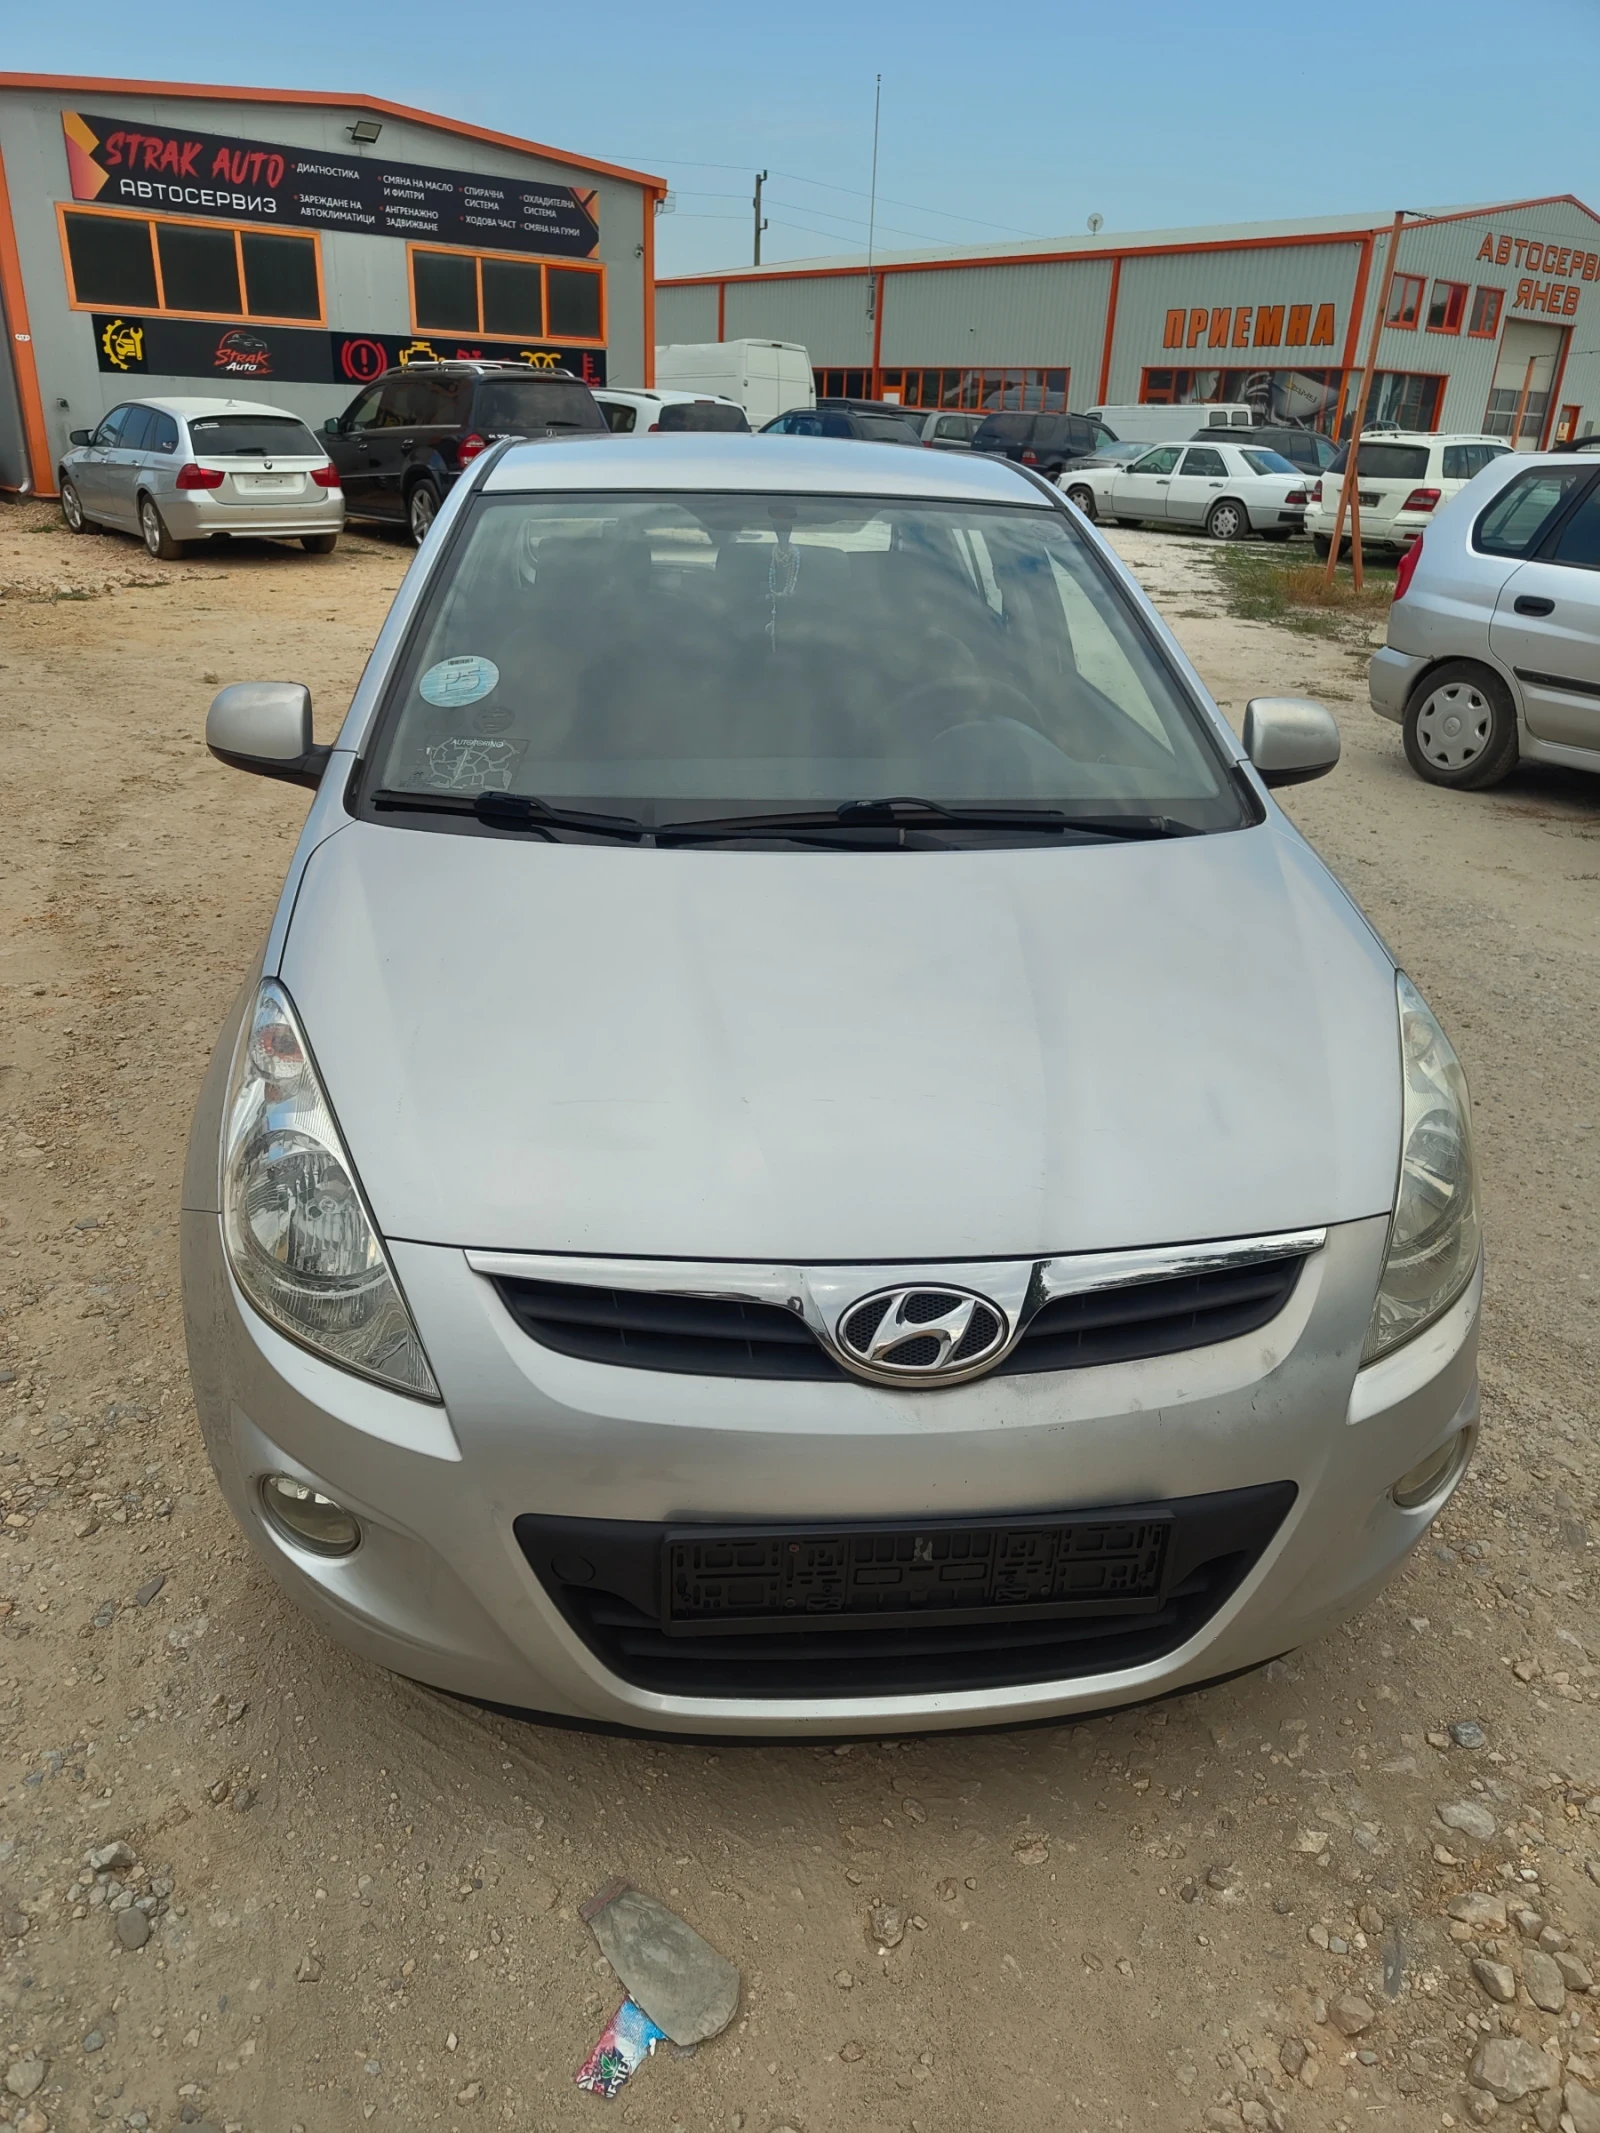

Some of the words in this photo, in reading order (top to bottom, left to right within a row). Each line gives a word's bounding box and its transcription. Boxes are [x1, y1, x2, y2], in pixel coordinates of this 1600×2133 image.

[104, 131, 203, 178] STRAK
[211, 148, 285, 188] AUTO
[297, 162, 360, 180] ДИАГНОСТИКА
[382, 174, 412, 187] СМЯНА
[412, 178, 425, 189] НА
[425, 180, 454, 192] МАСЛО
[119, 178, 278, 213] АВТОСЕРВИЗ
[383, 187, 391, 197] И
[391, 188, 425, 201] ФИЛТРИ
[464, 186, 505, 200] СПИРАЧНА
[299, 193, 349, 208] ЗАРЕЖДАНЕ
[350, 200, 363, 210] НА
[464, 198, 500, 211] СИСТЕМА
[523, 194, 576, 209] ОХЛАДИТЕЛНА
[300, 206, 376, 225] АВТОКЛИМАТИЦИ
[385, 205, 439, 220] АНГРЕНАЖНО
[523, 206, 557, 218] СИСТЕМА
[386, 217, 439, 232] ЗАДВИЖВАНЕ
[465, 215, 497, 227] ХОДОВА
[497, 218, 517, 229] ЧАСТ
[524, 222, 549, 233] СМЯНА
[550, 225, 560, 234] НА
[560, 226, 580, 237] ГУМИ
[1512, 277, 1580, 316] ЯНЕВ
[1163, 303, 1335, 349] ПРИЕМНА
